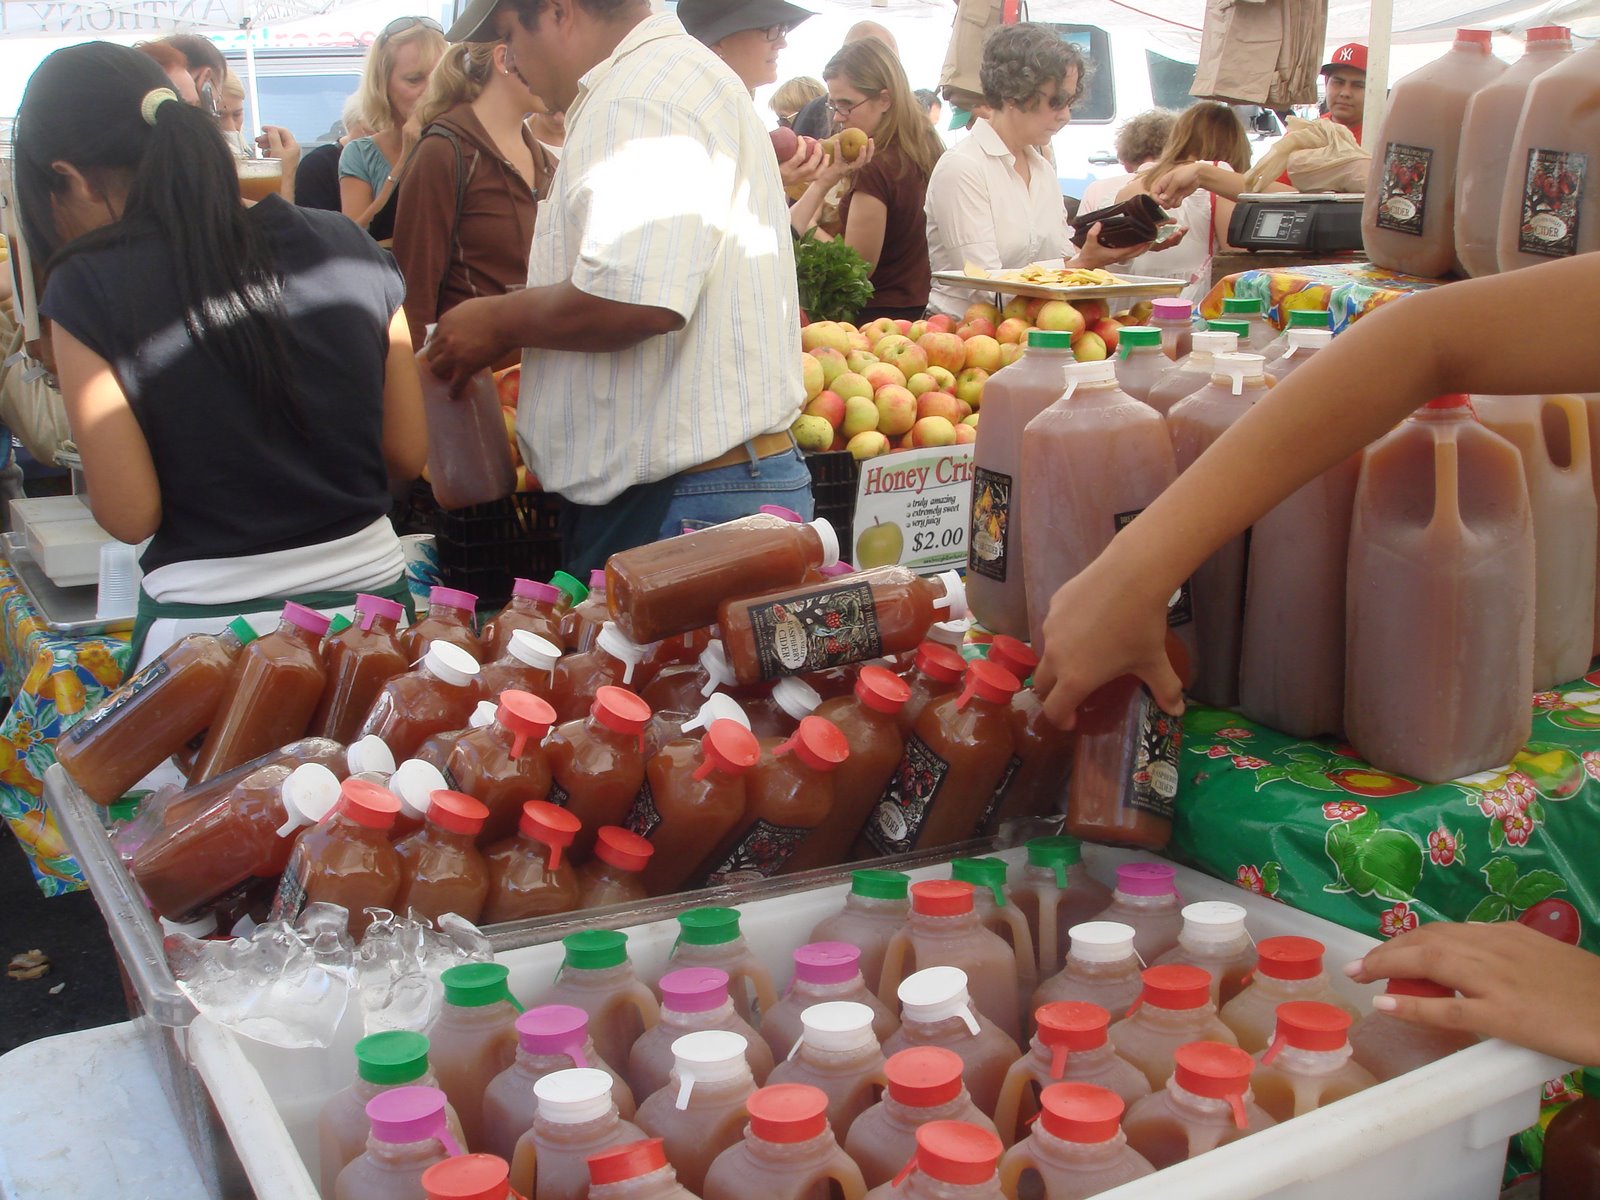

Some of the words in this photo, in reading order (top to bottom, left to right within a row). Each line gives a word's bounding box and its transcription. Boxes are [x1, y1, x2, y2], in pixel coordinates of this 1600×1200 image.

[1339, 47, 1354, 61] NY
[864, 465, 930, 495] Honey
[911, 505, 942, 518] extremely
[942, 503, 959, 514] sweet
[912, 497, 928, 509] truly
[930, 494, 956, 506] amazing
[911, 519, 926, 529] very
[924, 516, 941, 528] juicy
[912, 527, 963, 552] $2.00
[778, 629, 790, 659] CIDER
[787, 620, 801, 662] RASPBERRY
[881, 811, 900, 836] CIDER
